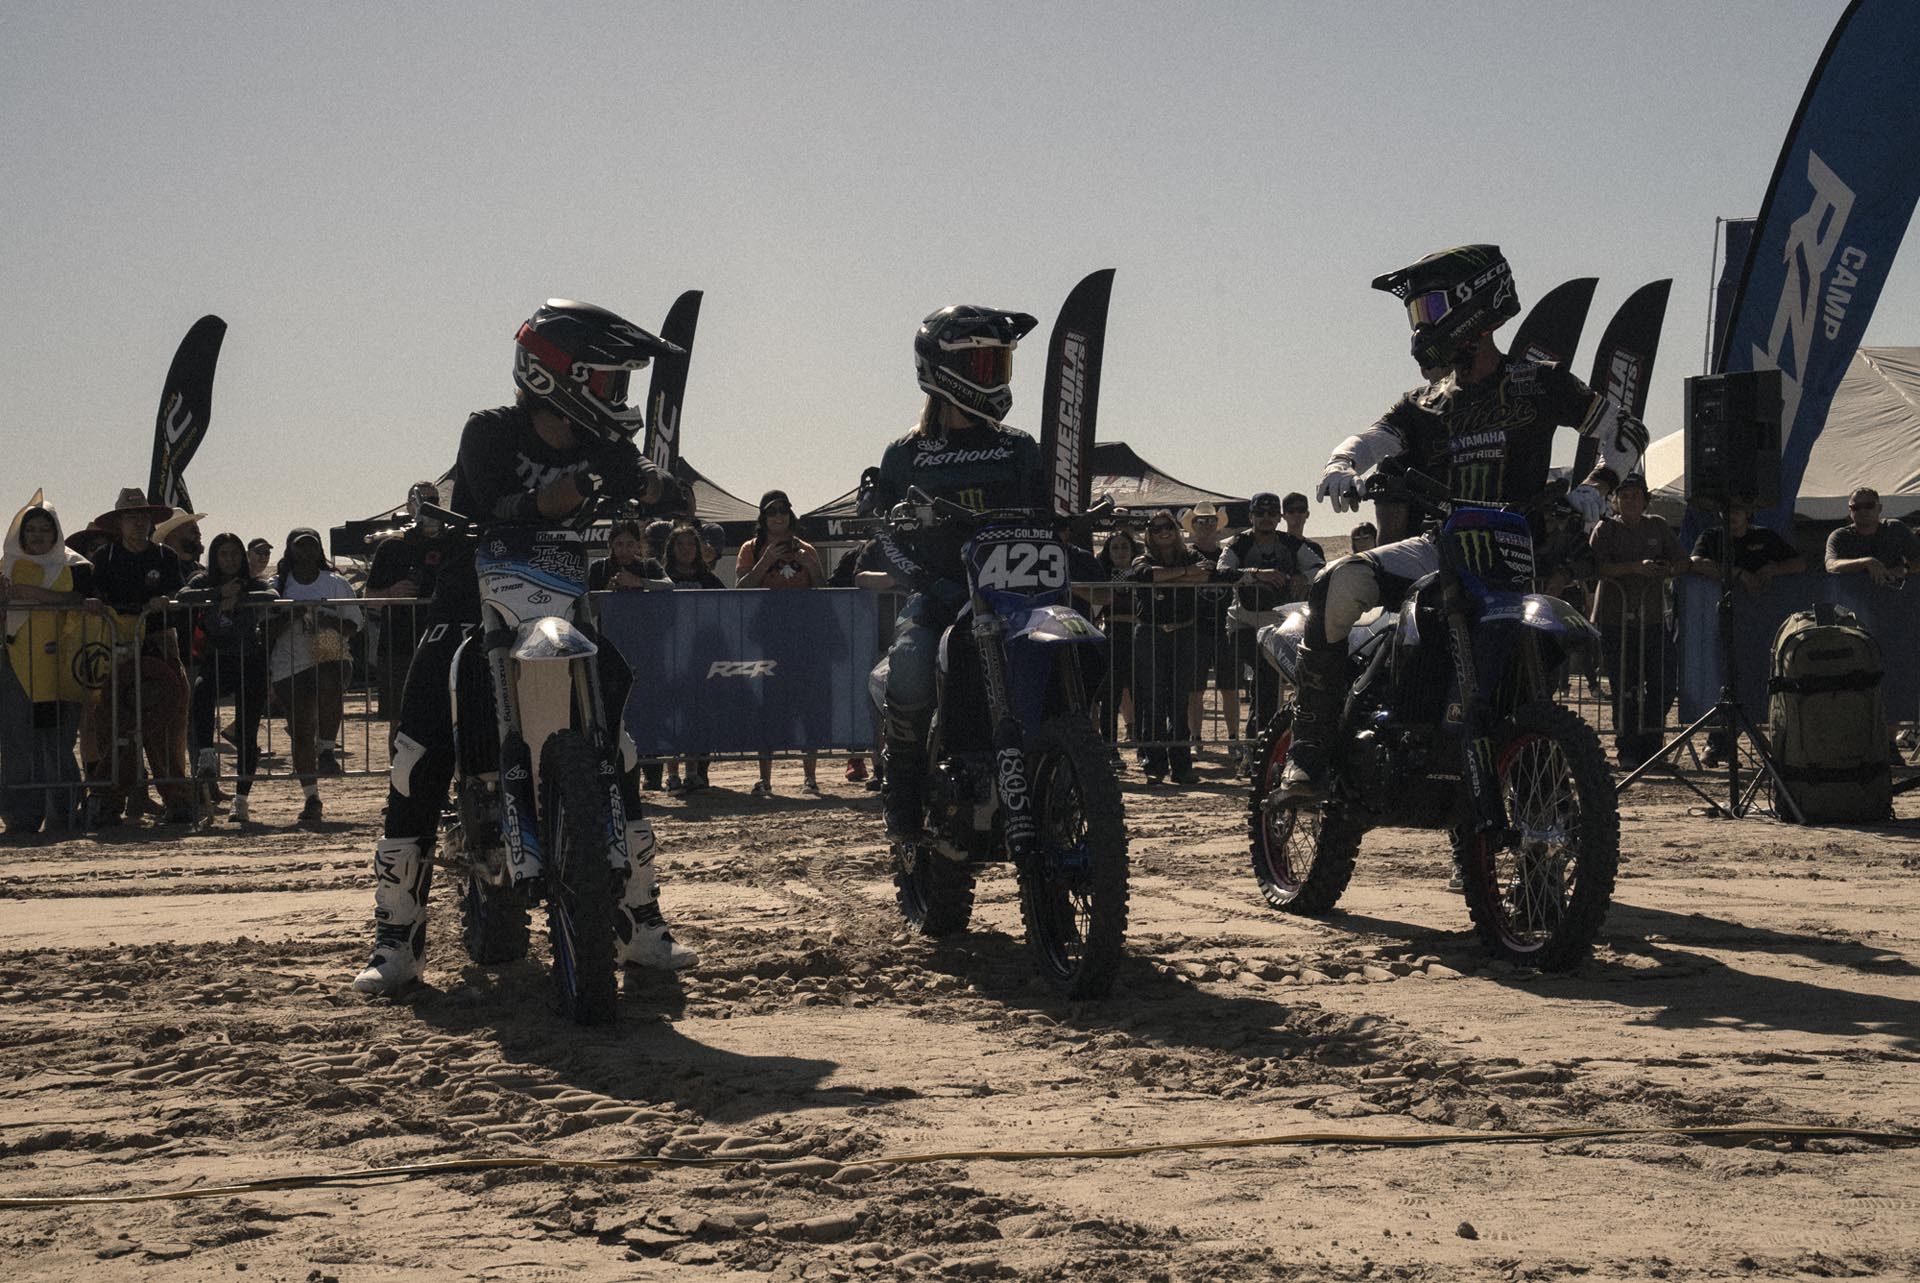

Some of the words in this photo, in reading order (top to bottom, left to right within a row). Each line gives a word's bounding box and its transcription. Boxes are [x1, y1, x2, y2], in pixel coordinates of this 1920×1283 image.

[1824, 246, 1867, 341] CAMP
[934, 370, 975, 399] MONSTER
[913, 446, 1015, 468] FASTHOUSE
[1458, 430, 1507, 449] YAMAHA
[1014, 528, 1053, 539] GOLDEN
[977, 542, 1066, 590] 423
[500, 582, 524, 593] THOR
[706, 660, 778, 680] RZR
[1000, 758, 1031, 811] 805
[1466, 749, 1481, 798] ACERBIS
[504, 790, 525, 866] ACERBIS
[608, 782, 628, 857] ACERBIS
